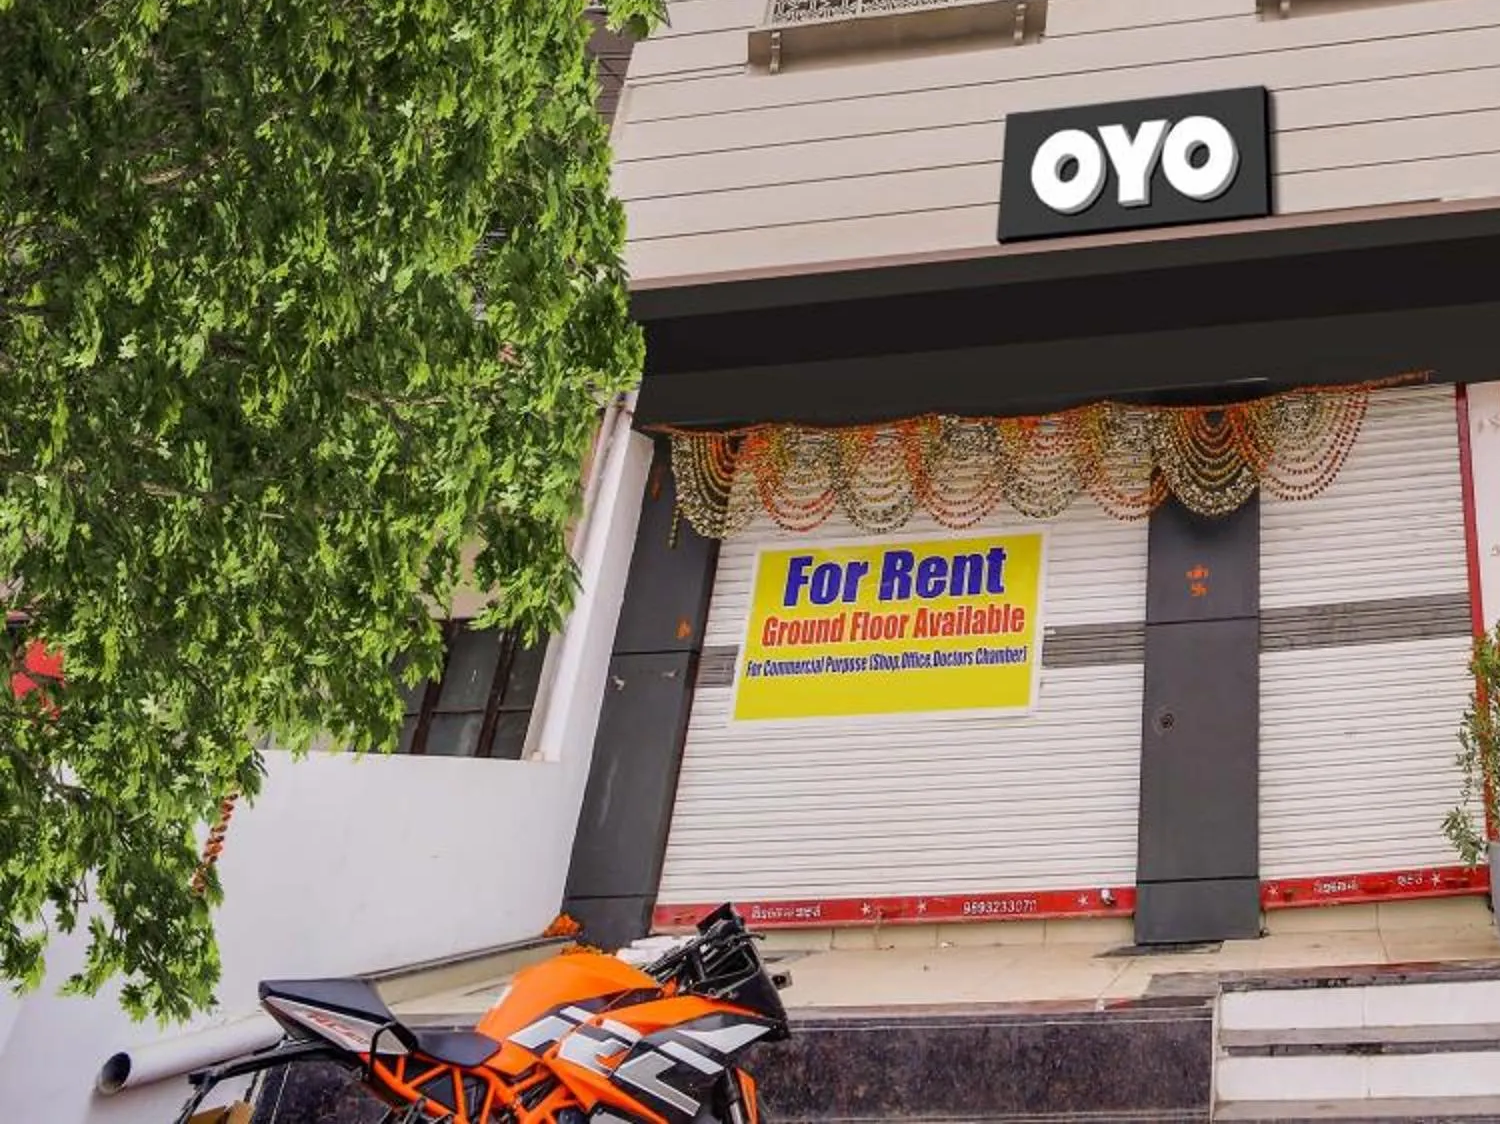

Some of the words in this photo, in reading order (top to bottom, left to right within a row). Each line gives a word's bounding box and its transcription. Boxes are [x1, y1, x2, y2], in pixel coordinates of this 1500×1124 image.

[1030, 115, 1239, 214] OYO
[783, 555, 869, 607] For
[878, 547, 1007, 602] Rent
[761, 612, 847, 647] Ground
[850, 610, 910, 642] Floor
[914, 603, 1026, 639] Available
[746, 659, 763, 677] For
[763, 656, 825, 677] Commercial
[825, 655, 868, 674] Purpose
